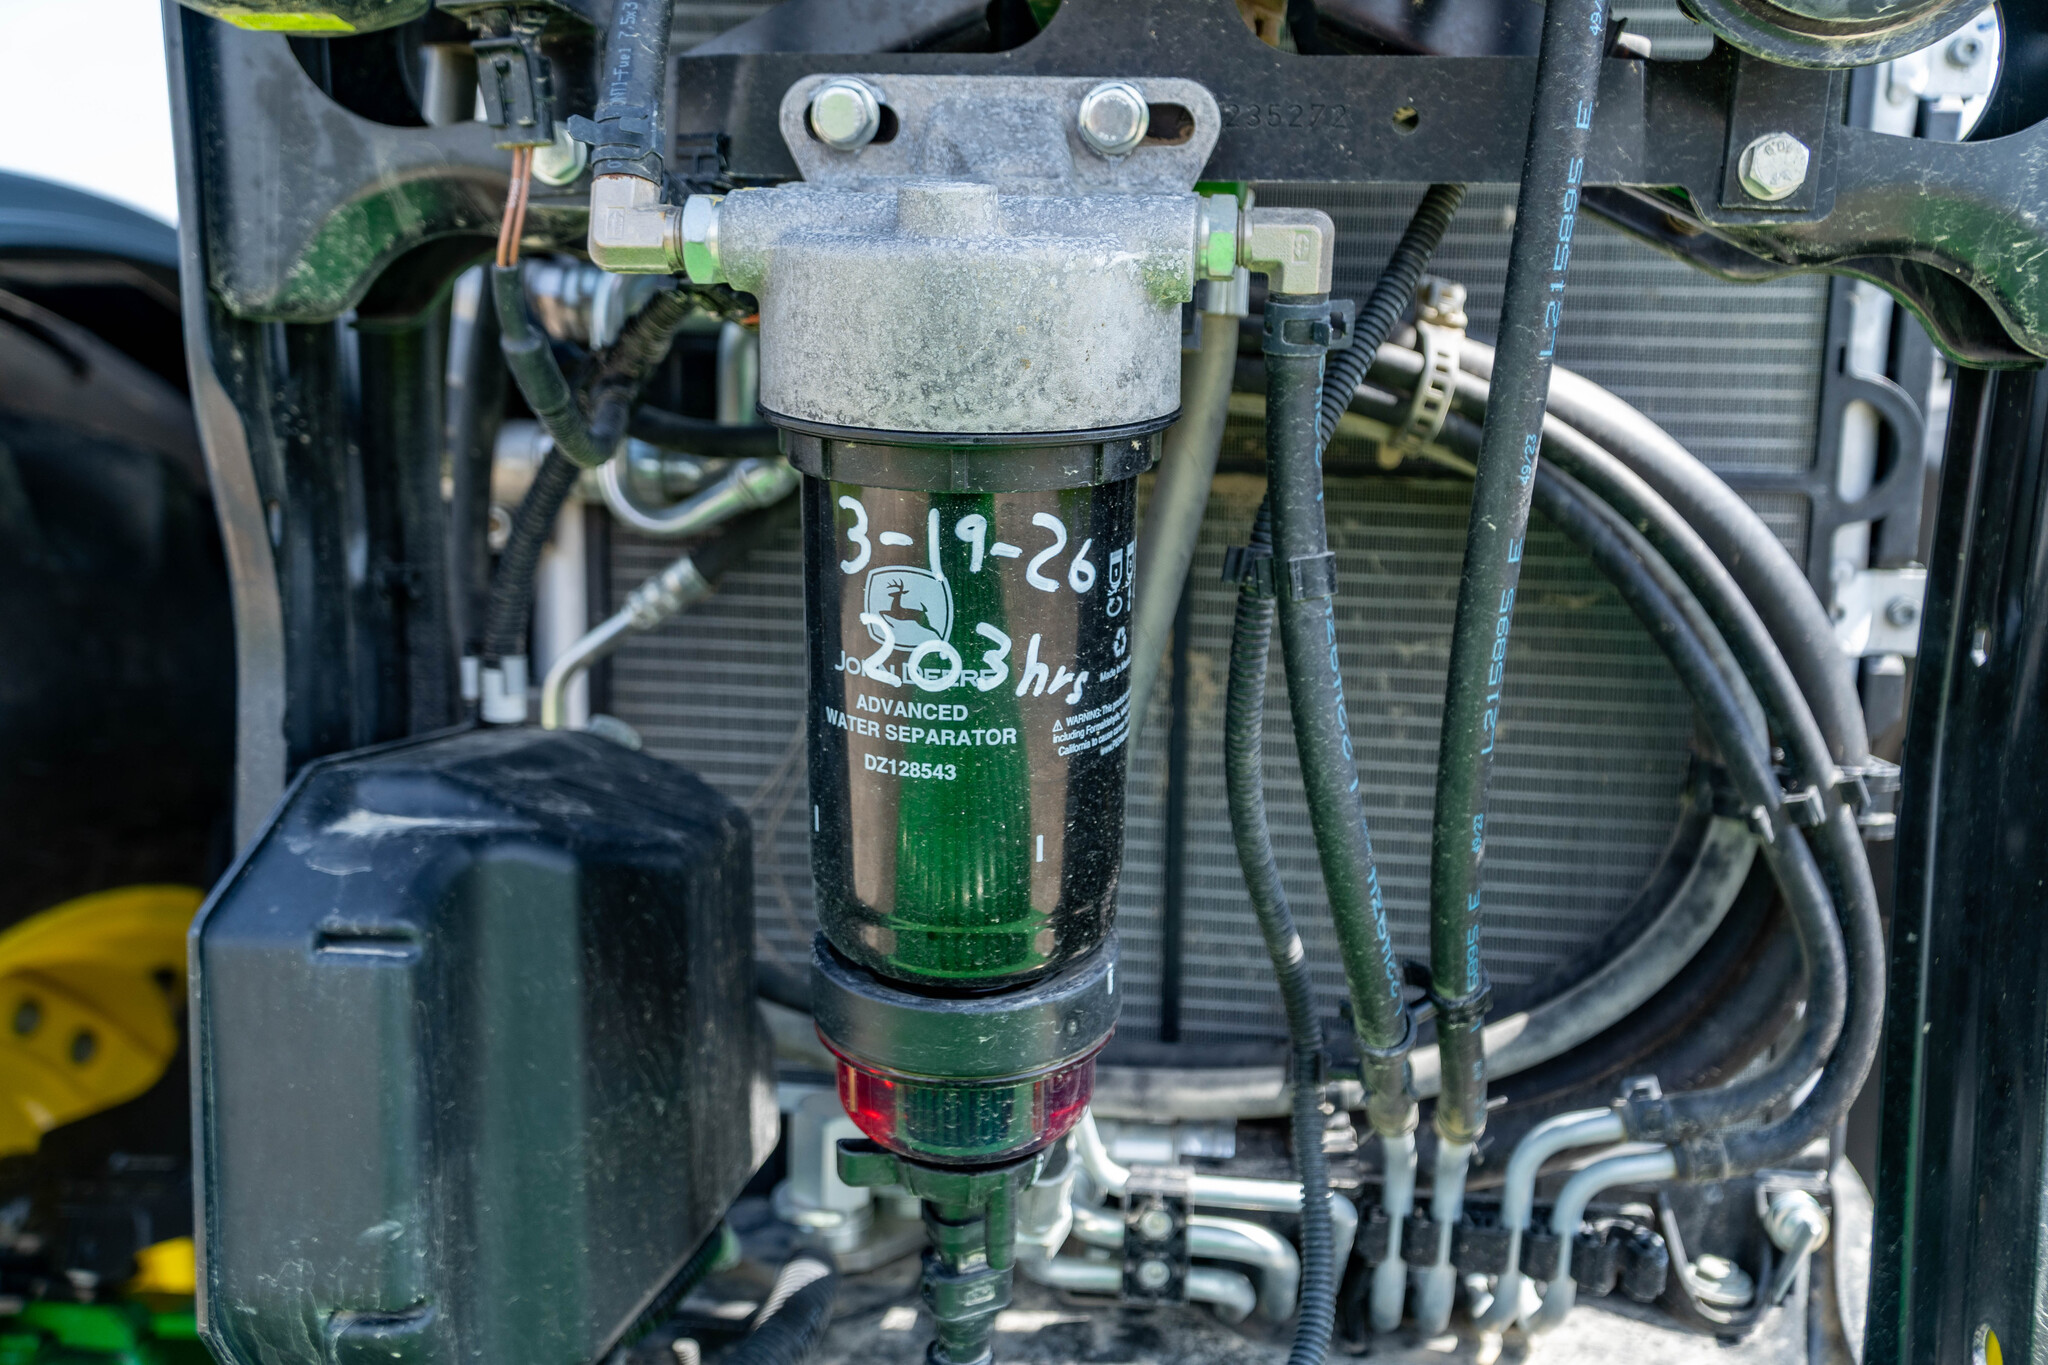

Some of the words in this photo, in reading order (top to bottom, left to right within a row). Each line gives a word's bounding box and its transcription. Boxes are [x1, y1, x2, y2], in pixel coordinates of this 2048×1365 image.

[1538, 156, 1585, 357] L215895
[1576, 100, 1593, 130] E
[839, 495, 1096, 594] 3-19-26
[1480, 587, 1515, 755] L215895
[1507, 536, 1523, 563] E
[1519, 433, 1537, 485] 49/23
[856, 694, 969, 722] ADVANCED
[1065, 707, 1102, 727] WARNING:
[825, 706, 880, 739] WATER
[885, 723, 1018, 747] SEPARATOR
[1053, 729, 1085, 744] including
[1058, 740, 1090, 757] California
[864, 753, 957, 781] DZ128543
[1467, 888, 1481, 912] E
